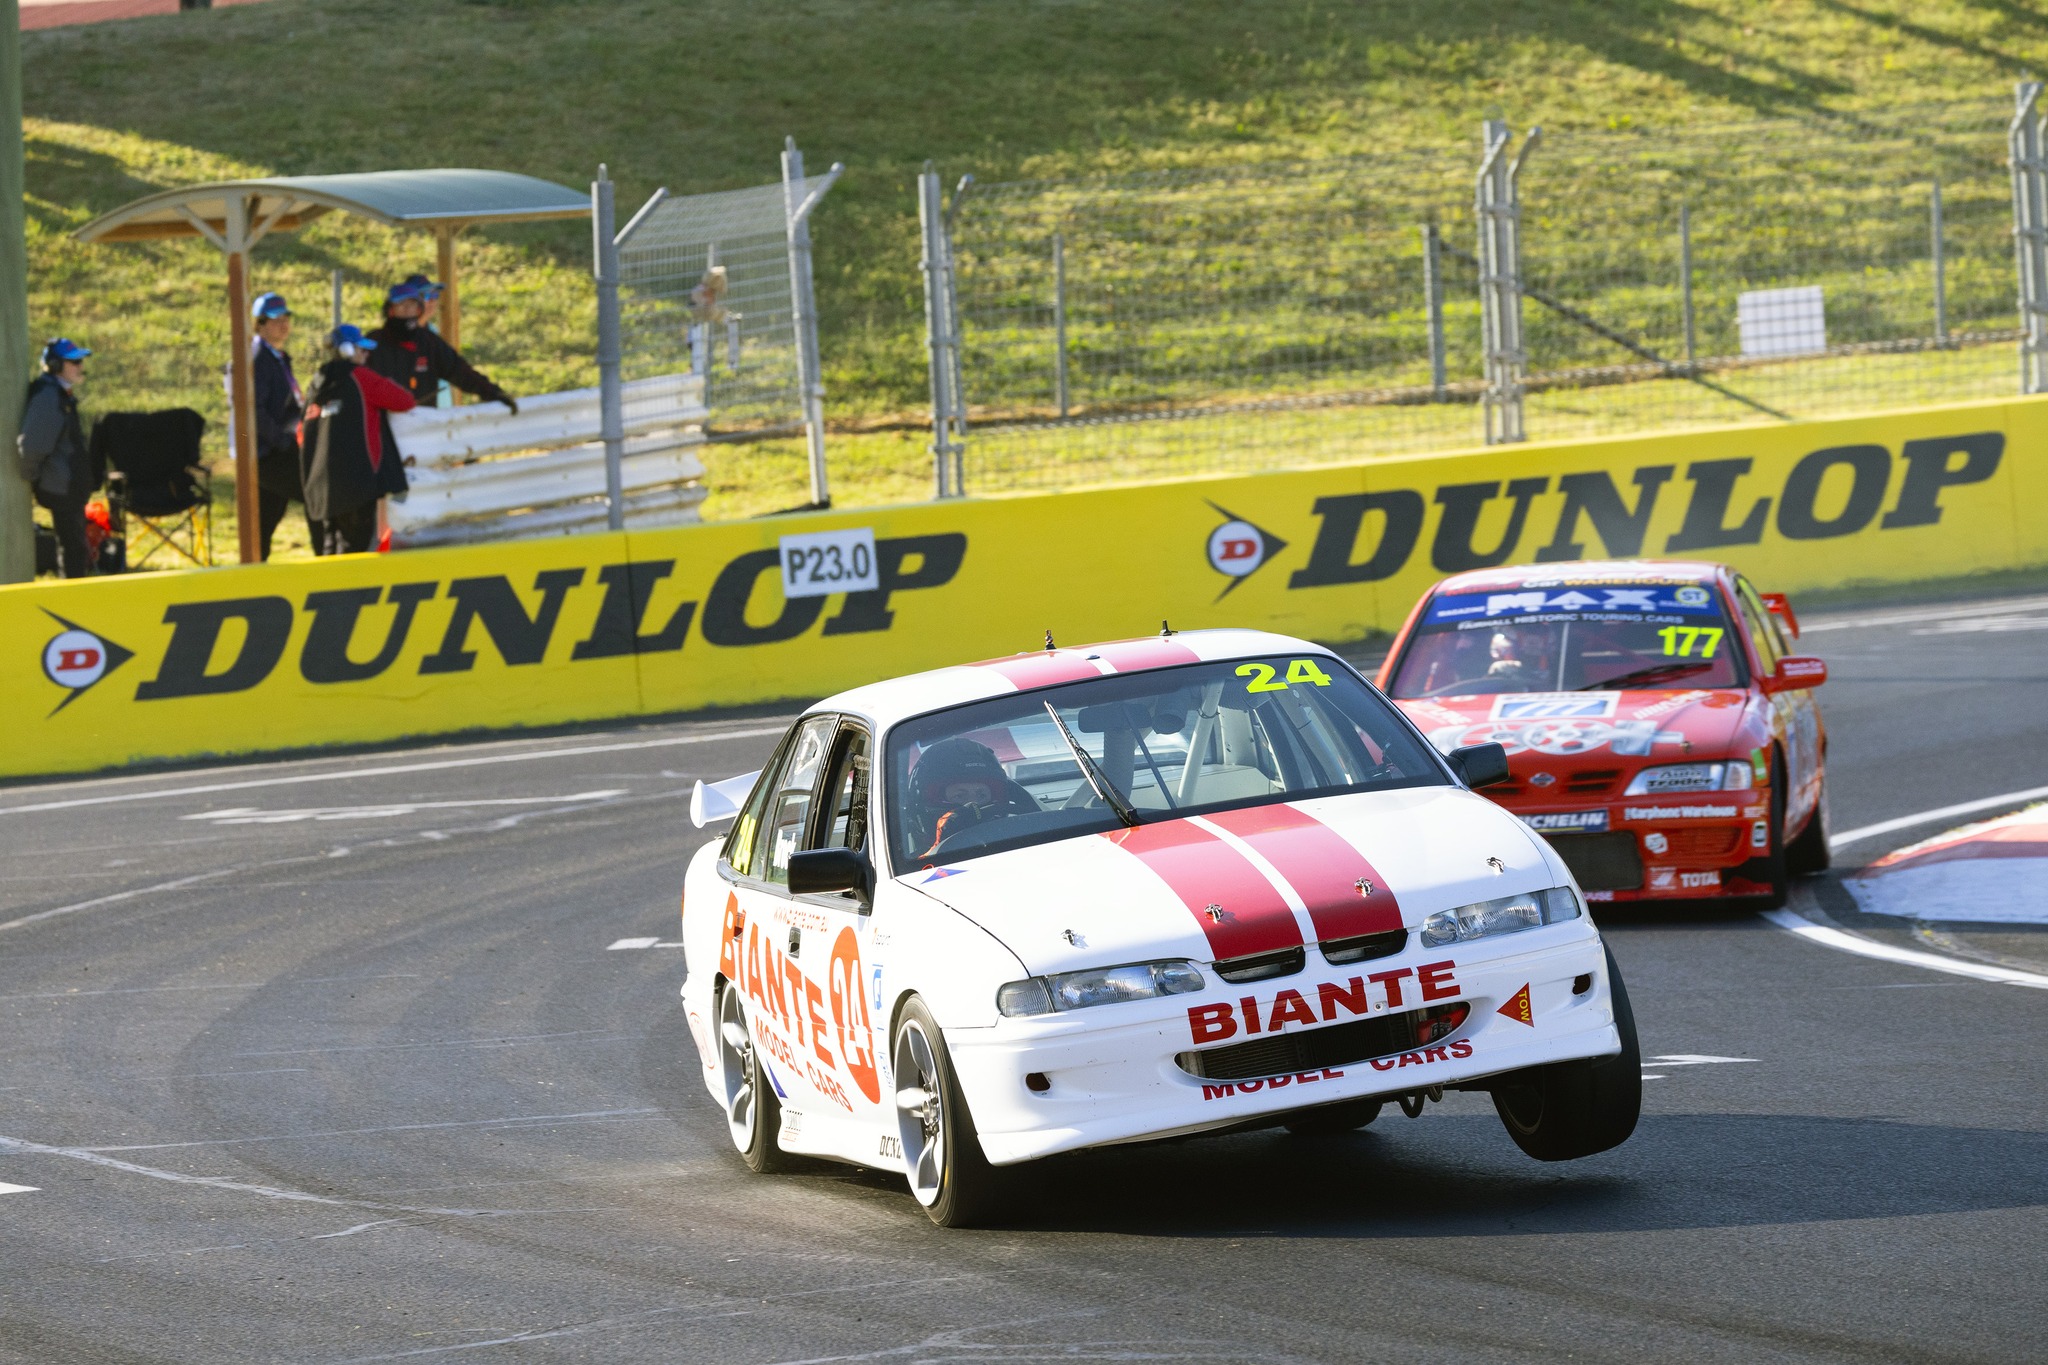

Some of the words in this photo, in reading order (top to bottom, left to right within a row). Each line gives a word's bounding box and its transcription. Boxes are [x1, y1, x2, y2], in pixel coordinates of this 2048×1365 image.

[1287, 432, 2005, 590] DUNLOP
[788, 543, 870, 585] P23.0
[1219, 539, 1257, 560] D
[133, 532, 968, 702] DUNLOP
[1581, 612, 1643, 623] TOURING
[1645, 613, 1685, 624] CARS
[1657, 625, 1724, 658] 177
[56, 648, 101, 673] D
[1236, 659, 1332, 694] 24
[1519, 812, 1605, 829] ICHELIN
[1680, 870, 1720, 888] TOTAL
[719, 890, 837, 1071] BIANTE
[832, 956, 874, 1069] 24
[1187, 959, 1461, 1045] BIANTE
[1518, 990, 1531, 1022] TOW
[754, 1014, 805, 1079] MODEL
[806, 1060, 854, 1113] CARS
